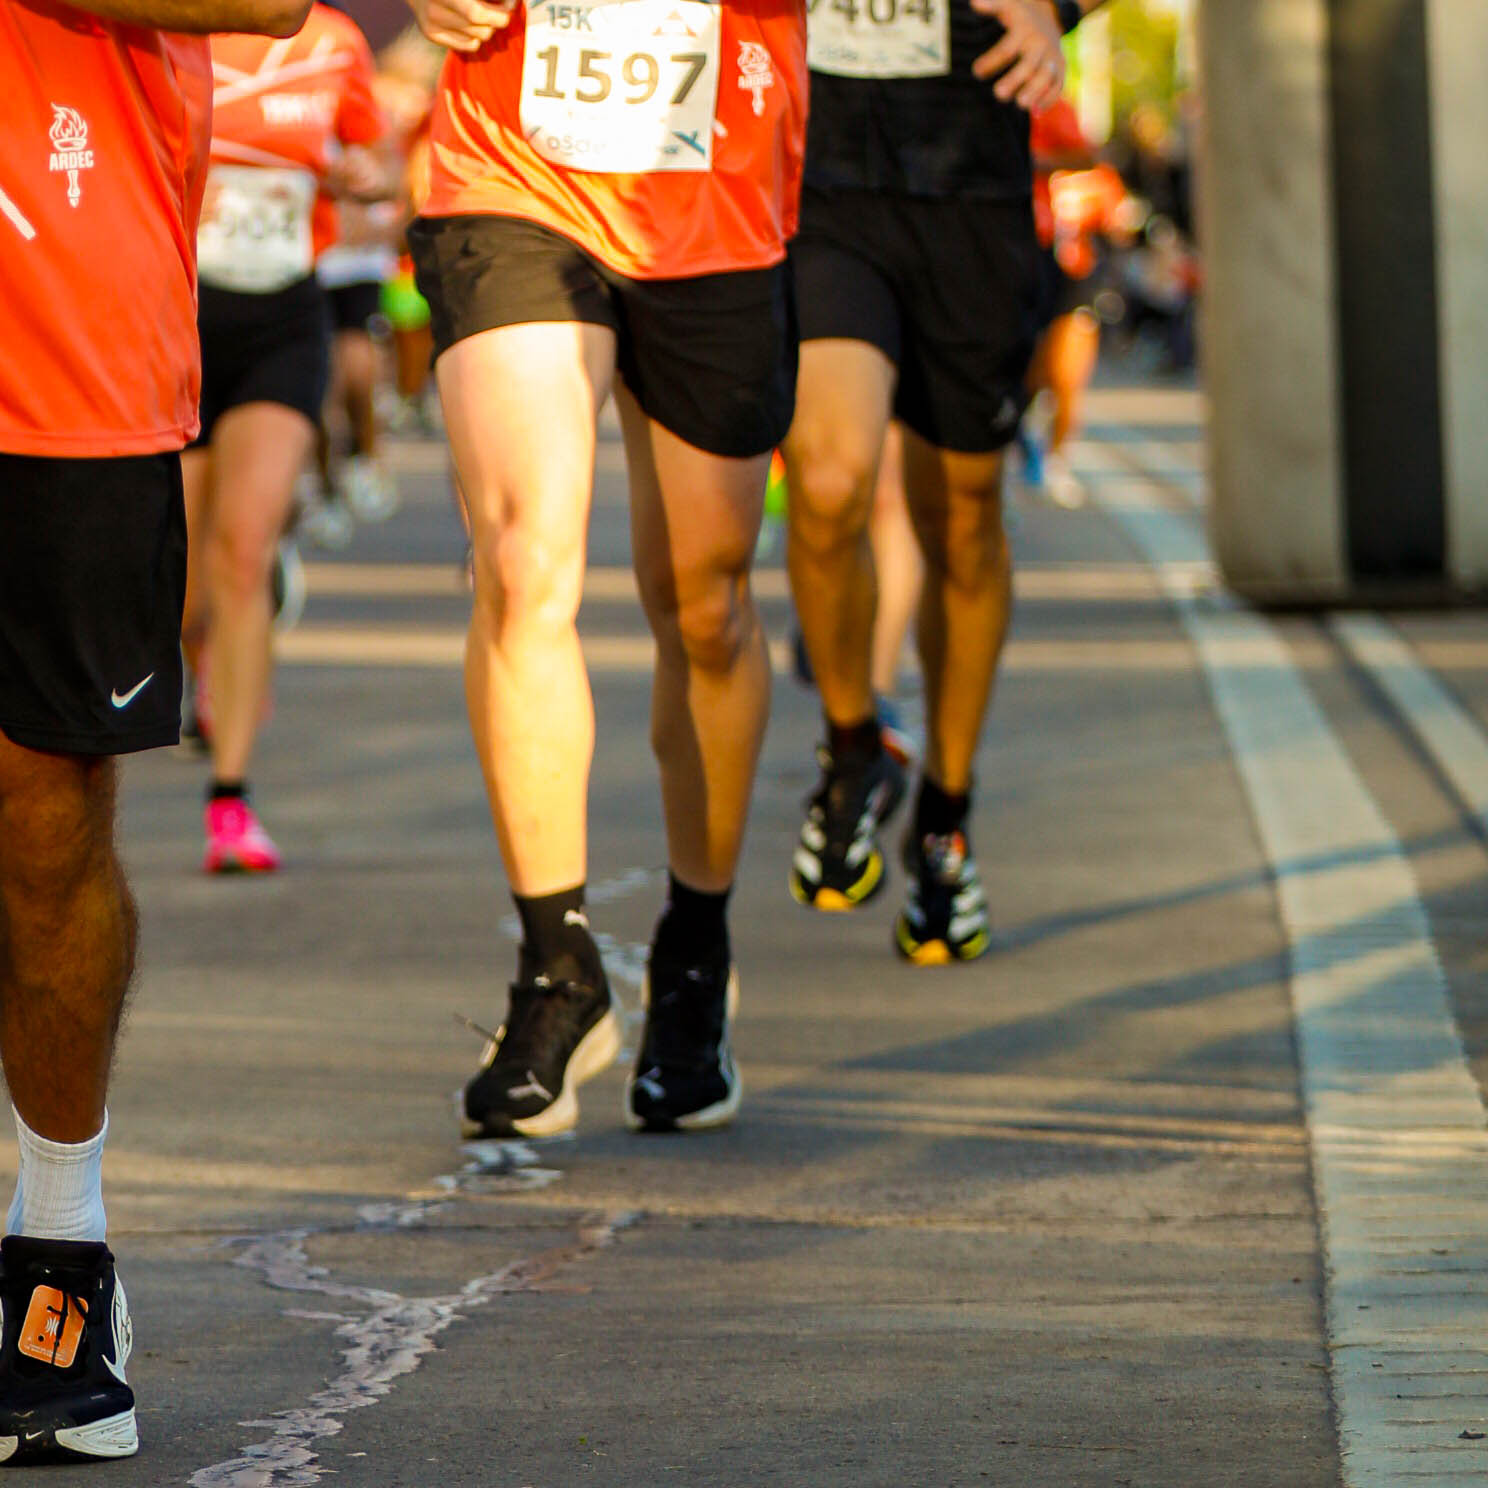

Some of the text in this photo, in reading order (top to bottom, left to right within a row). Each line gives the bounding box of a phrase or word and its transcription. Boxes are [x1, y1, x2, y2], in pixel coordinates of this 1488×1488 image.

[547, 5, 592, 31] 15K
[533, 45, 707, 105] 1597
[49, 150, 94, 171] ARDEC
